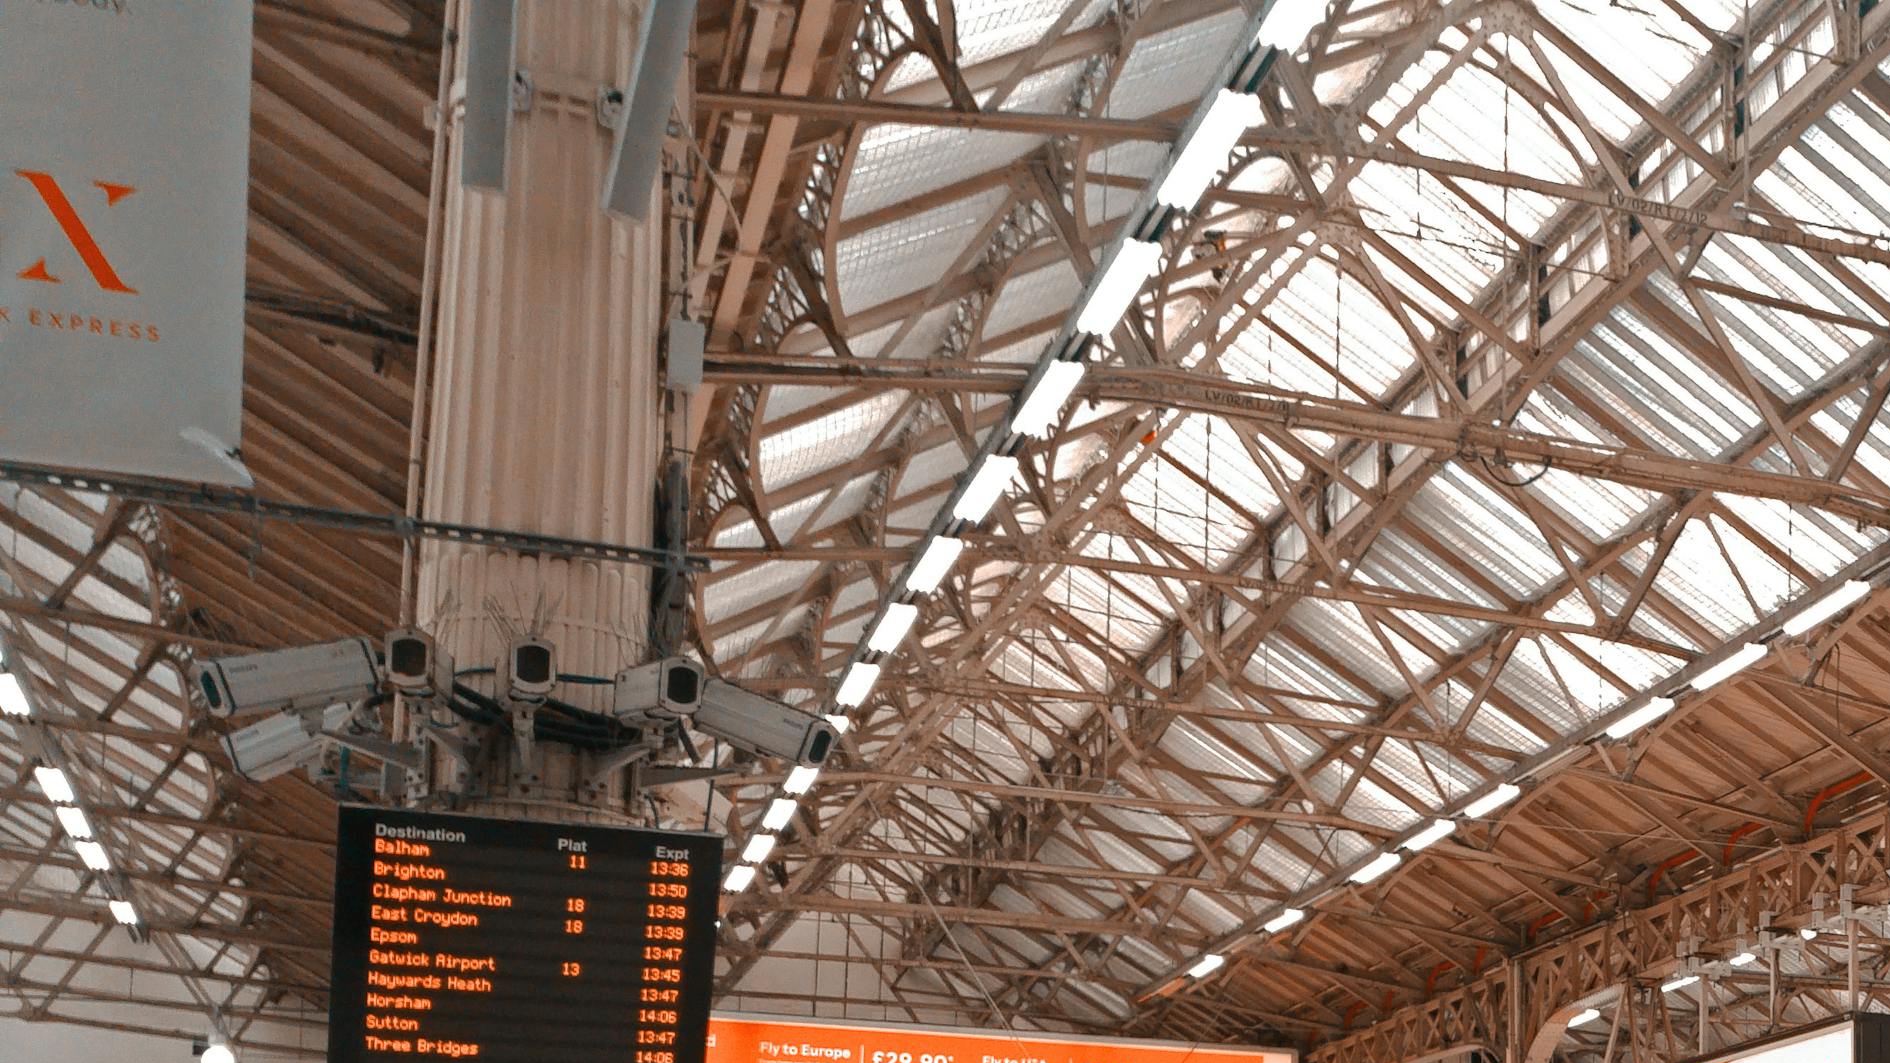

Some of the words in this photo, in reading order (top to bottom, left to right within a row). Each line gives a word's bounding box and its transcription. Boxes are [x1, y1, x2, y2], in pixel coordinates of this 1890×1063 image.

[28, 307, 160, 342] EXPRESS
[375, 823, 466, 843] Destination
[374, 839, 430, 857] Balham
[557, 838, 587, 853] Plat
[655, 846, 690, 861] Expt
[569, 855, 586, 869] 11
[650, 861, 689, 877] 13:36
[373, 862, 445, 881] Brighton
[372, 884, 437, 904] Clapham
[442, 891, 512, 908] Junction
[648, 883, 687, 898] 13:50
[566, 898, 585, 913] 18
[647, 904, 686, 919] 13:39
[371, 906, 407, 922] East
[414, 909, 478, 928] Croydon
[565, 919, 583, 934] 18
[644, 925, 684, 941] 13:39
[370, 928, 418, 948] Epsom
[369, 950, 430, 968] Gatwick
[435, 954, 496, 973] Airport
[643, 947, 683, 962] 13:47
[561, 962, 580, 977] 13
[641, 968, 681, 983] 13:45
[367, 972, 441, 991] Haywards
[447, 977, 492, 992] Heath
[367, 992, 432, 1010] Horsham
[640, 988, 679, 1003] 13:47
[366, 1014, 419, 1031] Sutton
[639, 1009, 677, 1024] 14:06
[637, 1030, 676, 1045] 13:47
[365, 1036, 411, 1053] Three
[417, 1039, 479, 1056] Bridges
[759, 1041, 779, 1057] Fly
[782, 1043, 798, 1056] to
[800, 1043, 851, 1060] Europe
